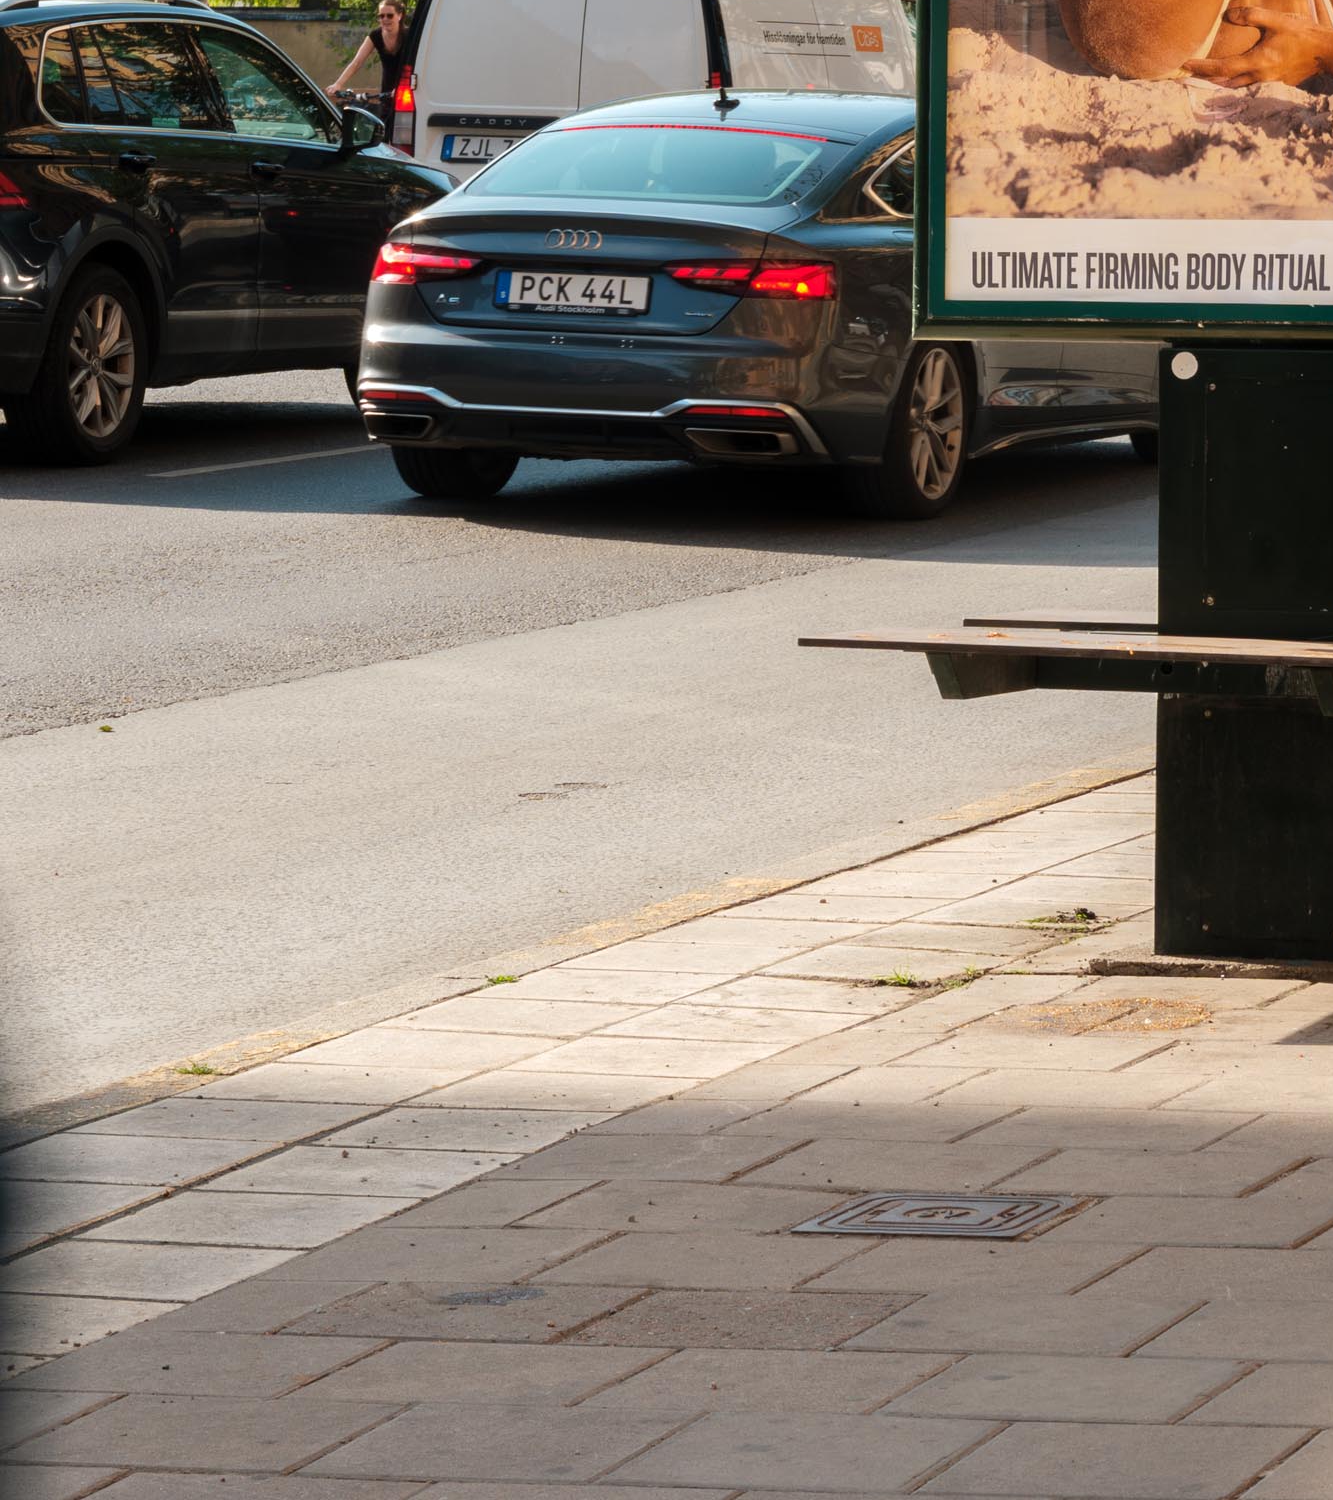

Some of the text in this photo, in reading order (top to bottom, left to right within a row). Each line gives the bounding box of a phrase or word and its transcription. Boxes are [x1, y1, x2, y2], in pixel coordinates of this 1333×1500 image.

[459, 138, 493, 156] ZJL
[971, 250, 1331, 293] ULTIMATE FIRMING BODY RITUAL
[519, 275, 634, 305] PCK 44L
[535, 304, 606, 314] Audi Stockholm
